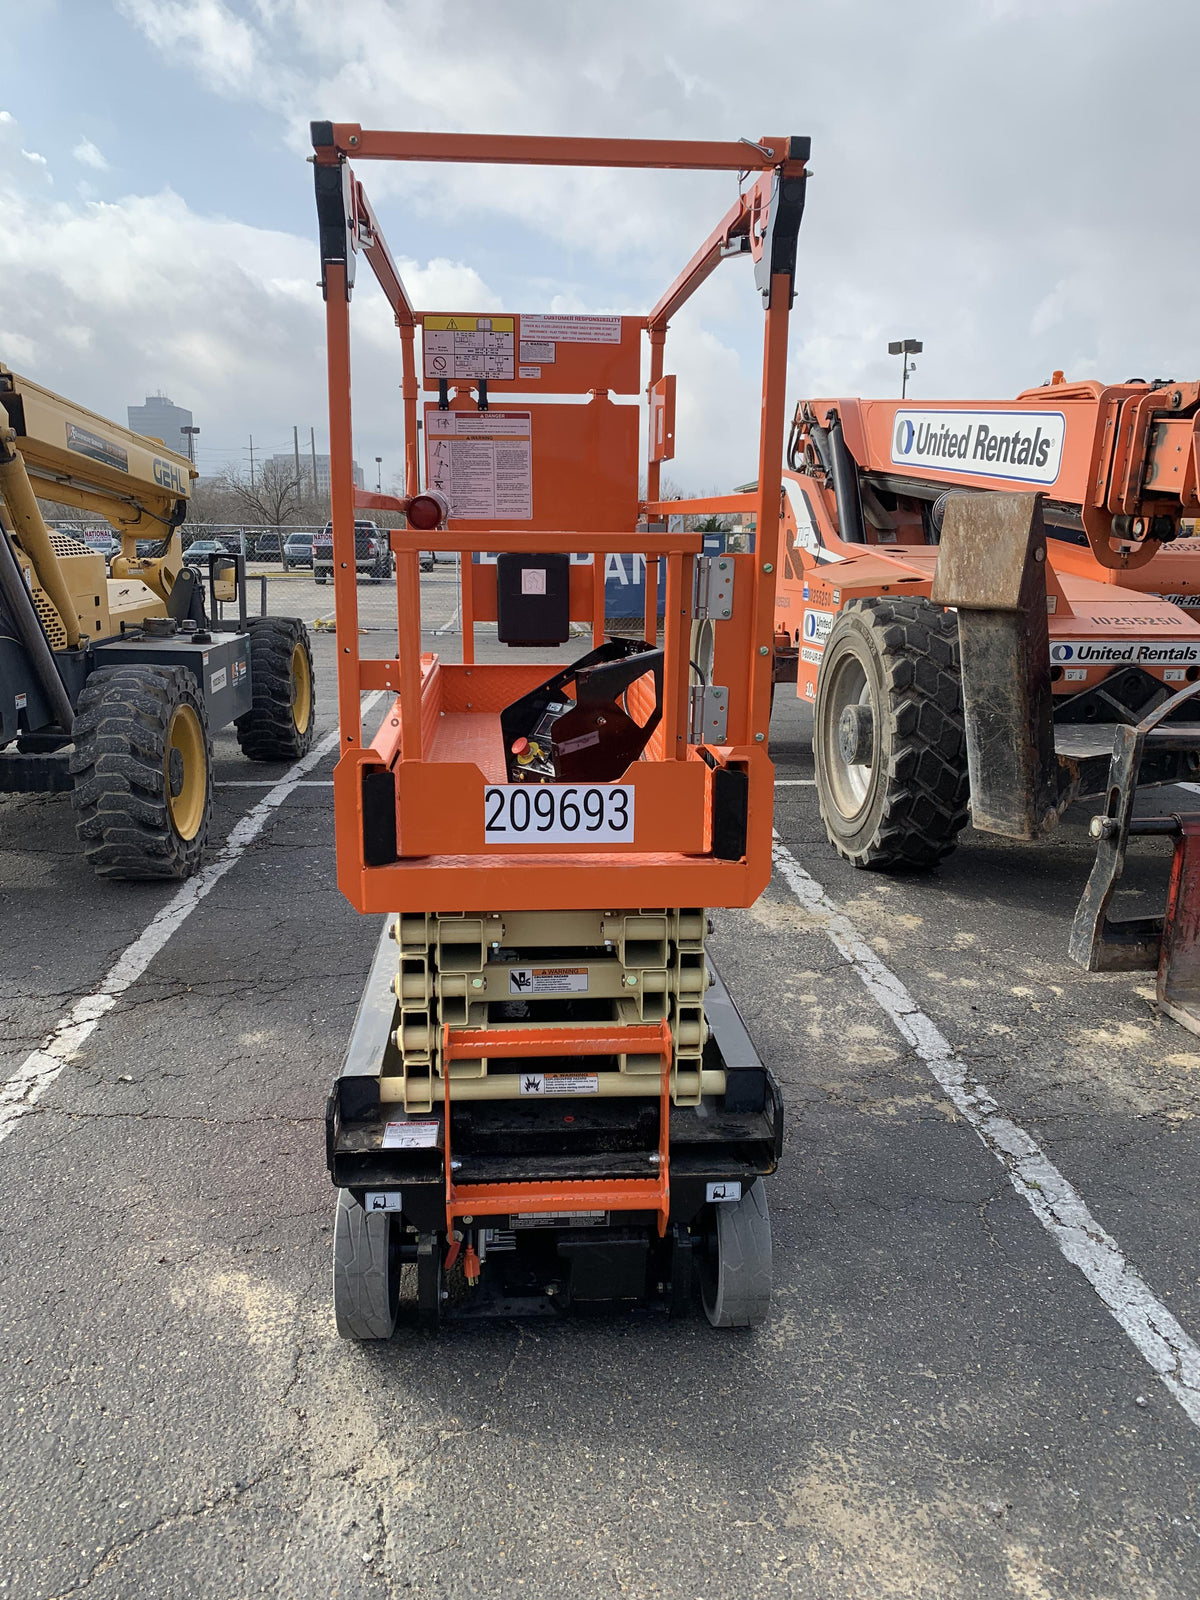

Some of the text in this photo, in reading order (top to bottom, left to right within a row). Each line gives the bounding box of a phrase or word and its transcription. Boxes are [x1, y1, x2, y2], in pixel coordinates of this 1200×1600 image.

[916, 422, 1050, 467] United Rentals
[153, 458, 186, 494] GEHL
[84, 529, 111, 538] NATIONAL
[1077, 645, 1198, 661] United Rentals
[485, 788, 629, 831] 209693
